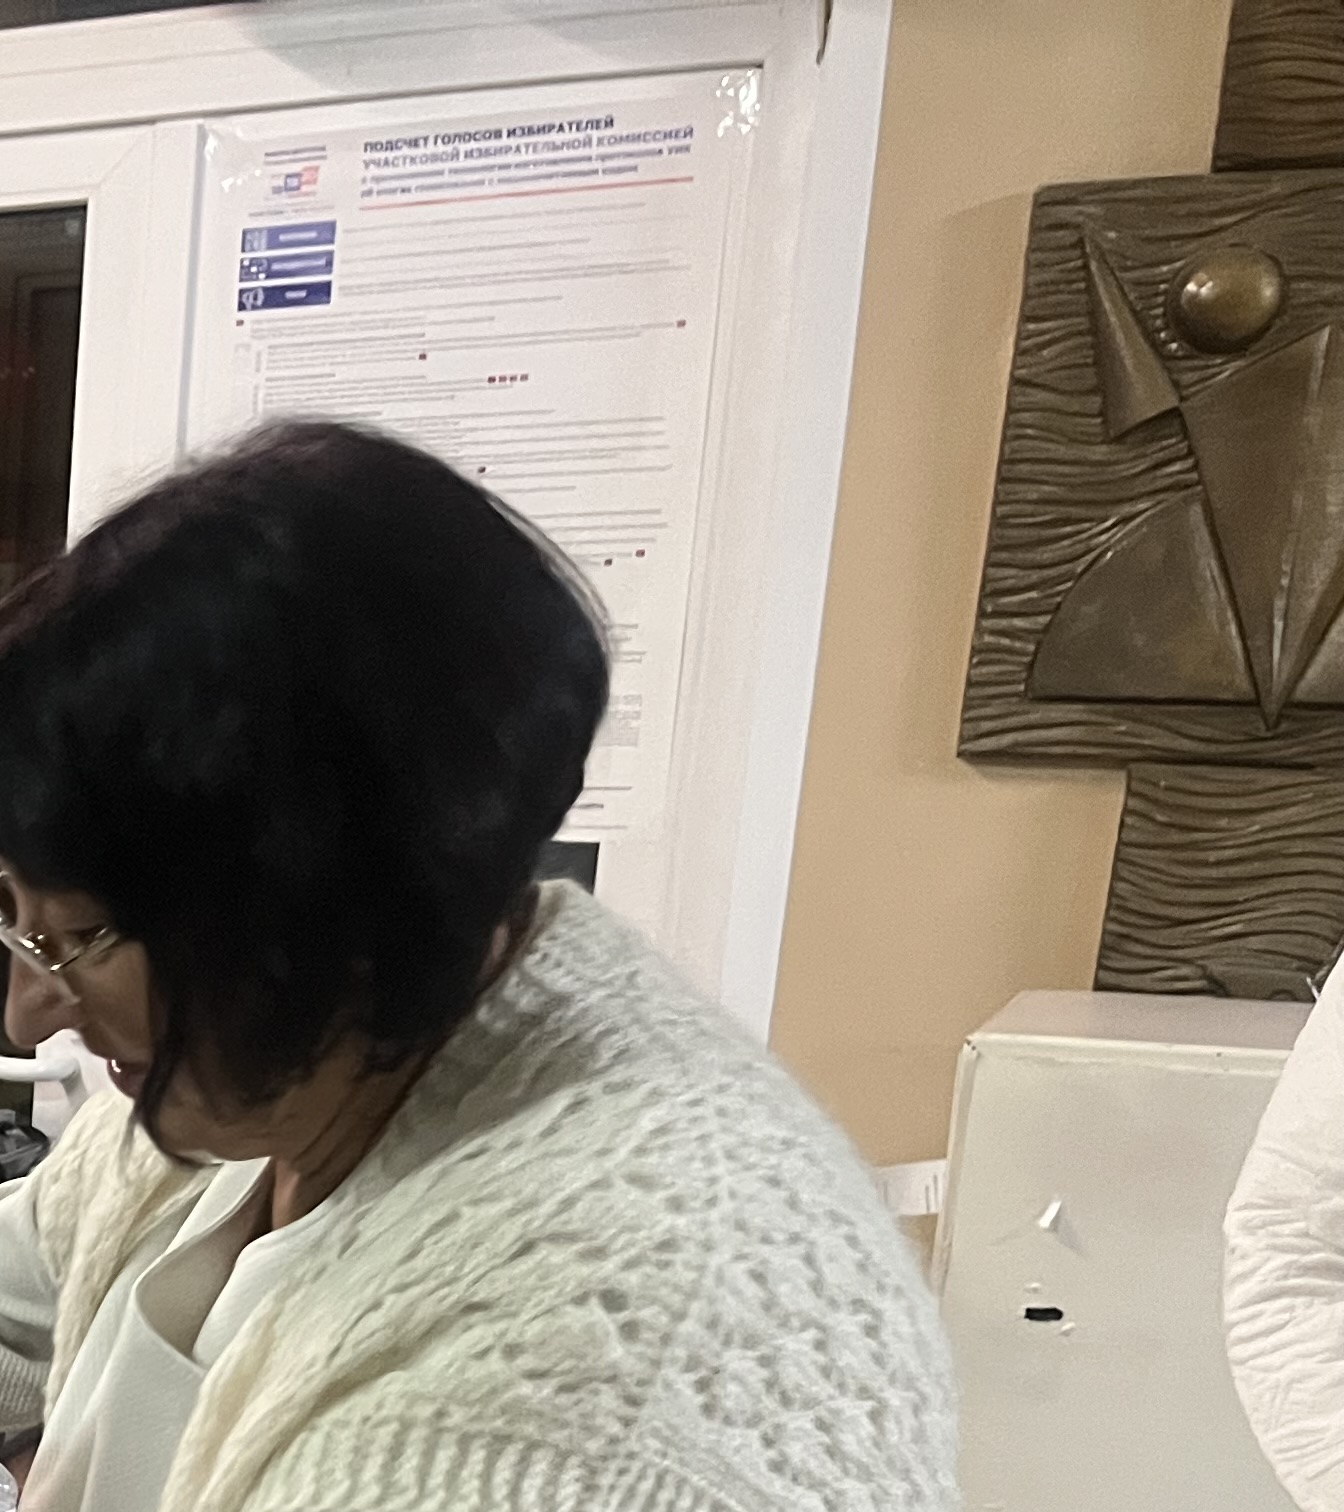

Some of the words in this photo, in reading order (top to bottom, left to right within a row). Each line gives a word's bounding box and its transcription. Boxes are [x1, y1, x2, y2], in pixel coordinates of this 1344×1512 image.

[362, 146, 460, 170] УЧАСТКОВОЙ
[463, 134, 593, 160] ИЗБИРАТЕЛЬНОЙ
[596, 124, 694, 148] КОМИССИЕЙ
[363, 134, 430, 153] ПОДСЧЕТ
[433, 127, 503, 146] ГОЛОСОВ
[506, 114, 615, 139] ИЗБИРАТЕЛЕЙ
